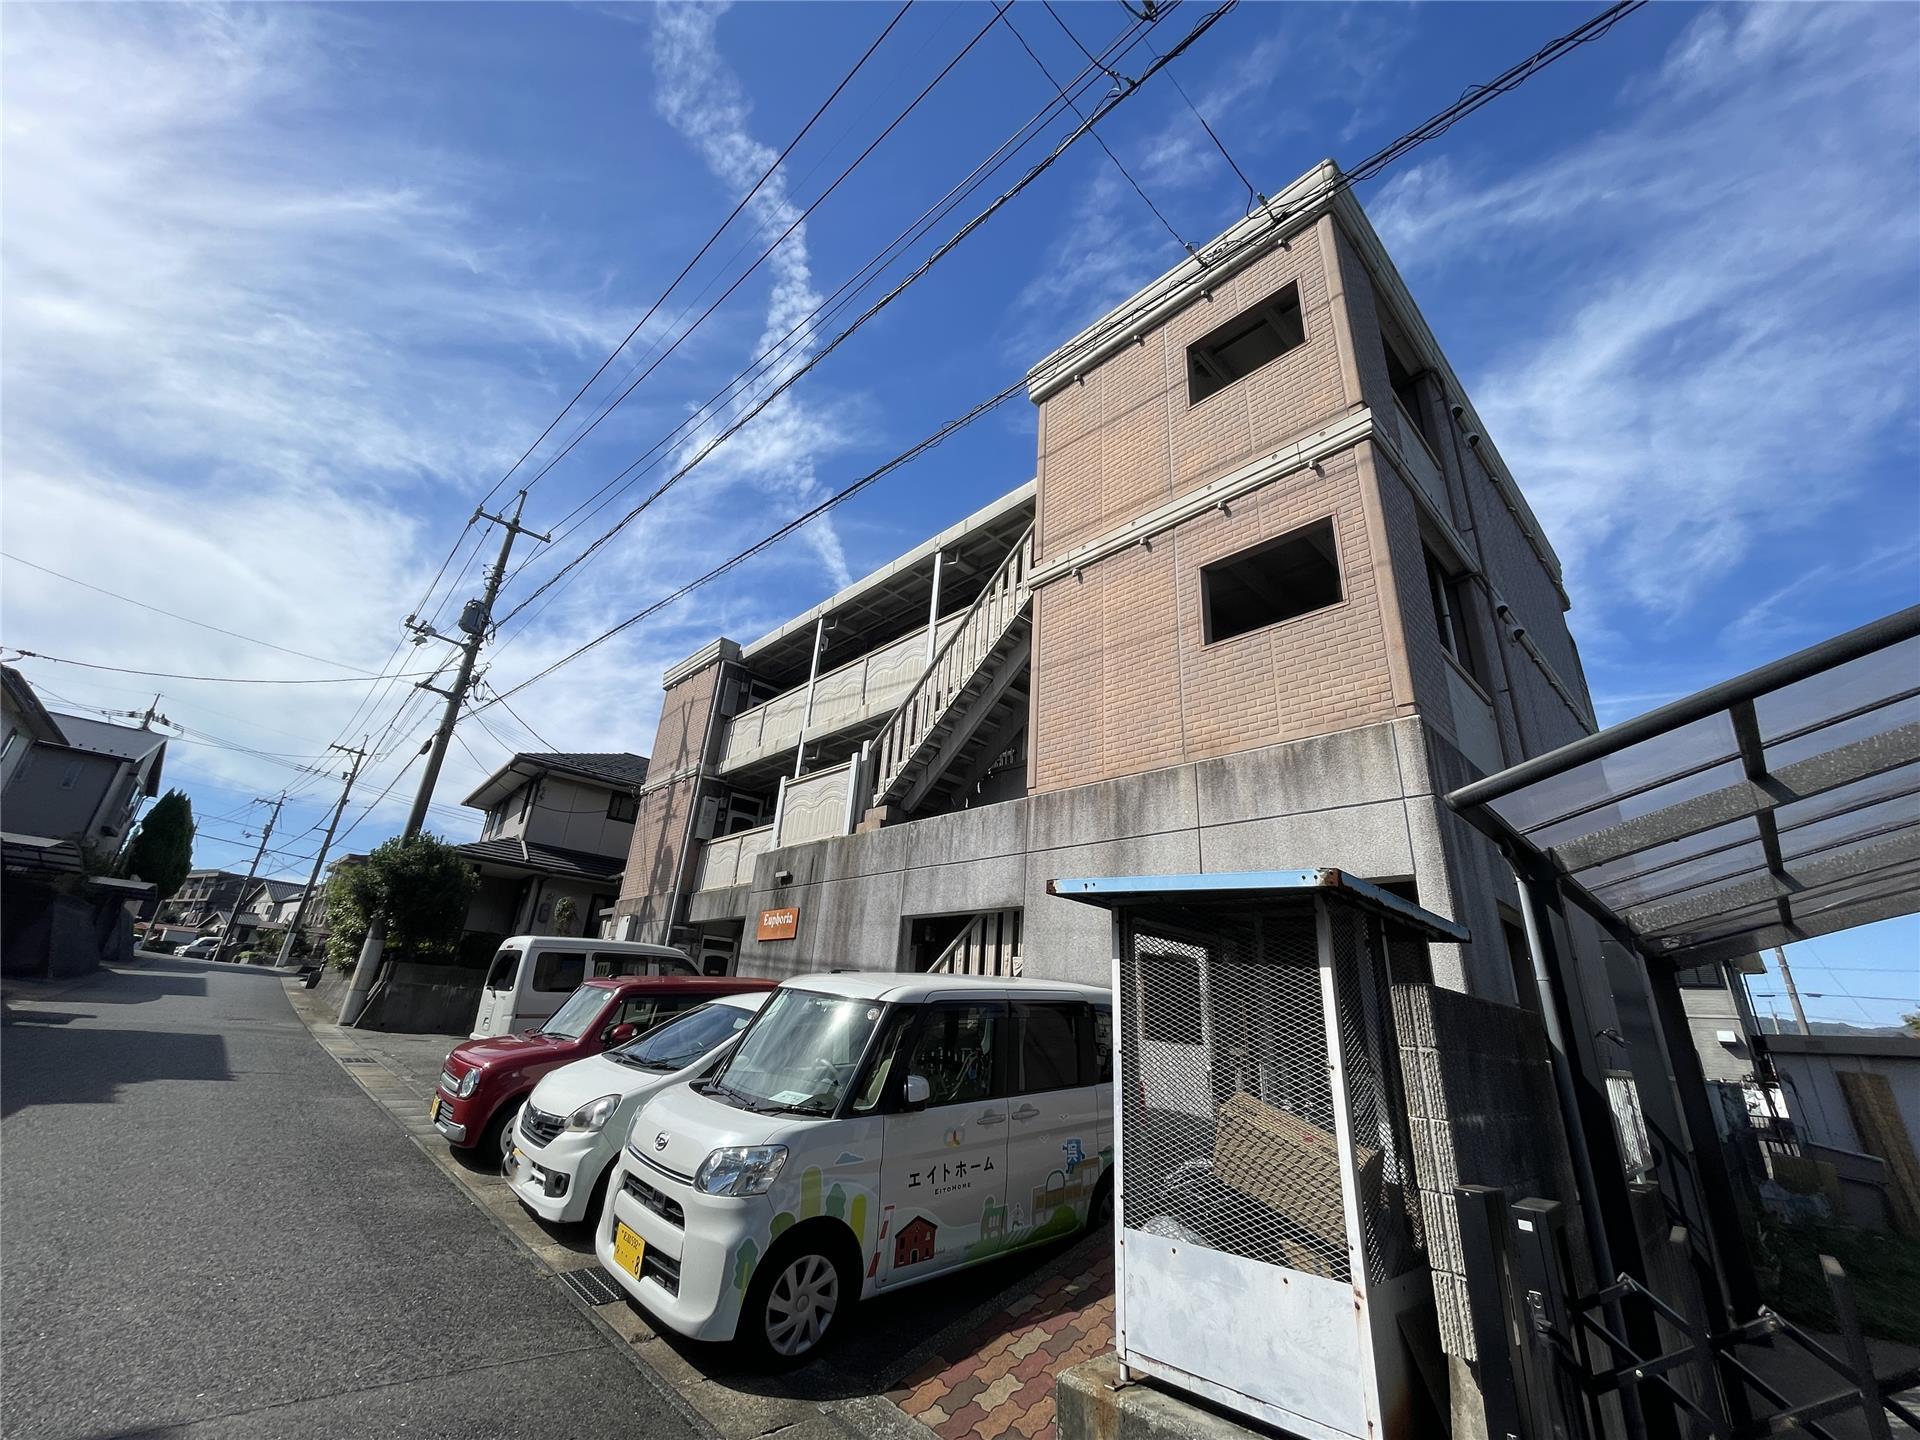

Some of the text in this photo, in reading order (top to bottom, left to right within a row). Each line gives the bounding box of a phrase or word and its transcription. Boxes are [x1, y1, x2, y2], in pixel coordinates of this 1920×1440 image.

[763, 912, 793, 928] Euphoria
[908, 1156, 994, 1188] エイトホーム
